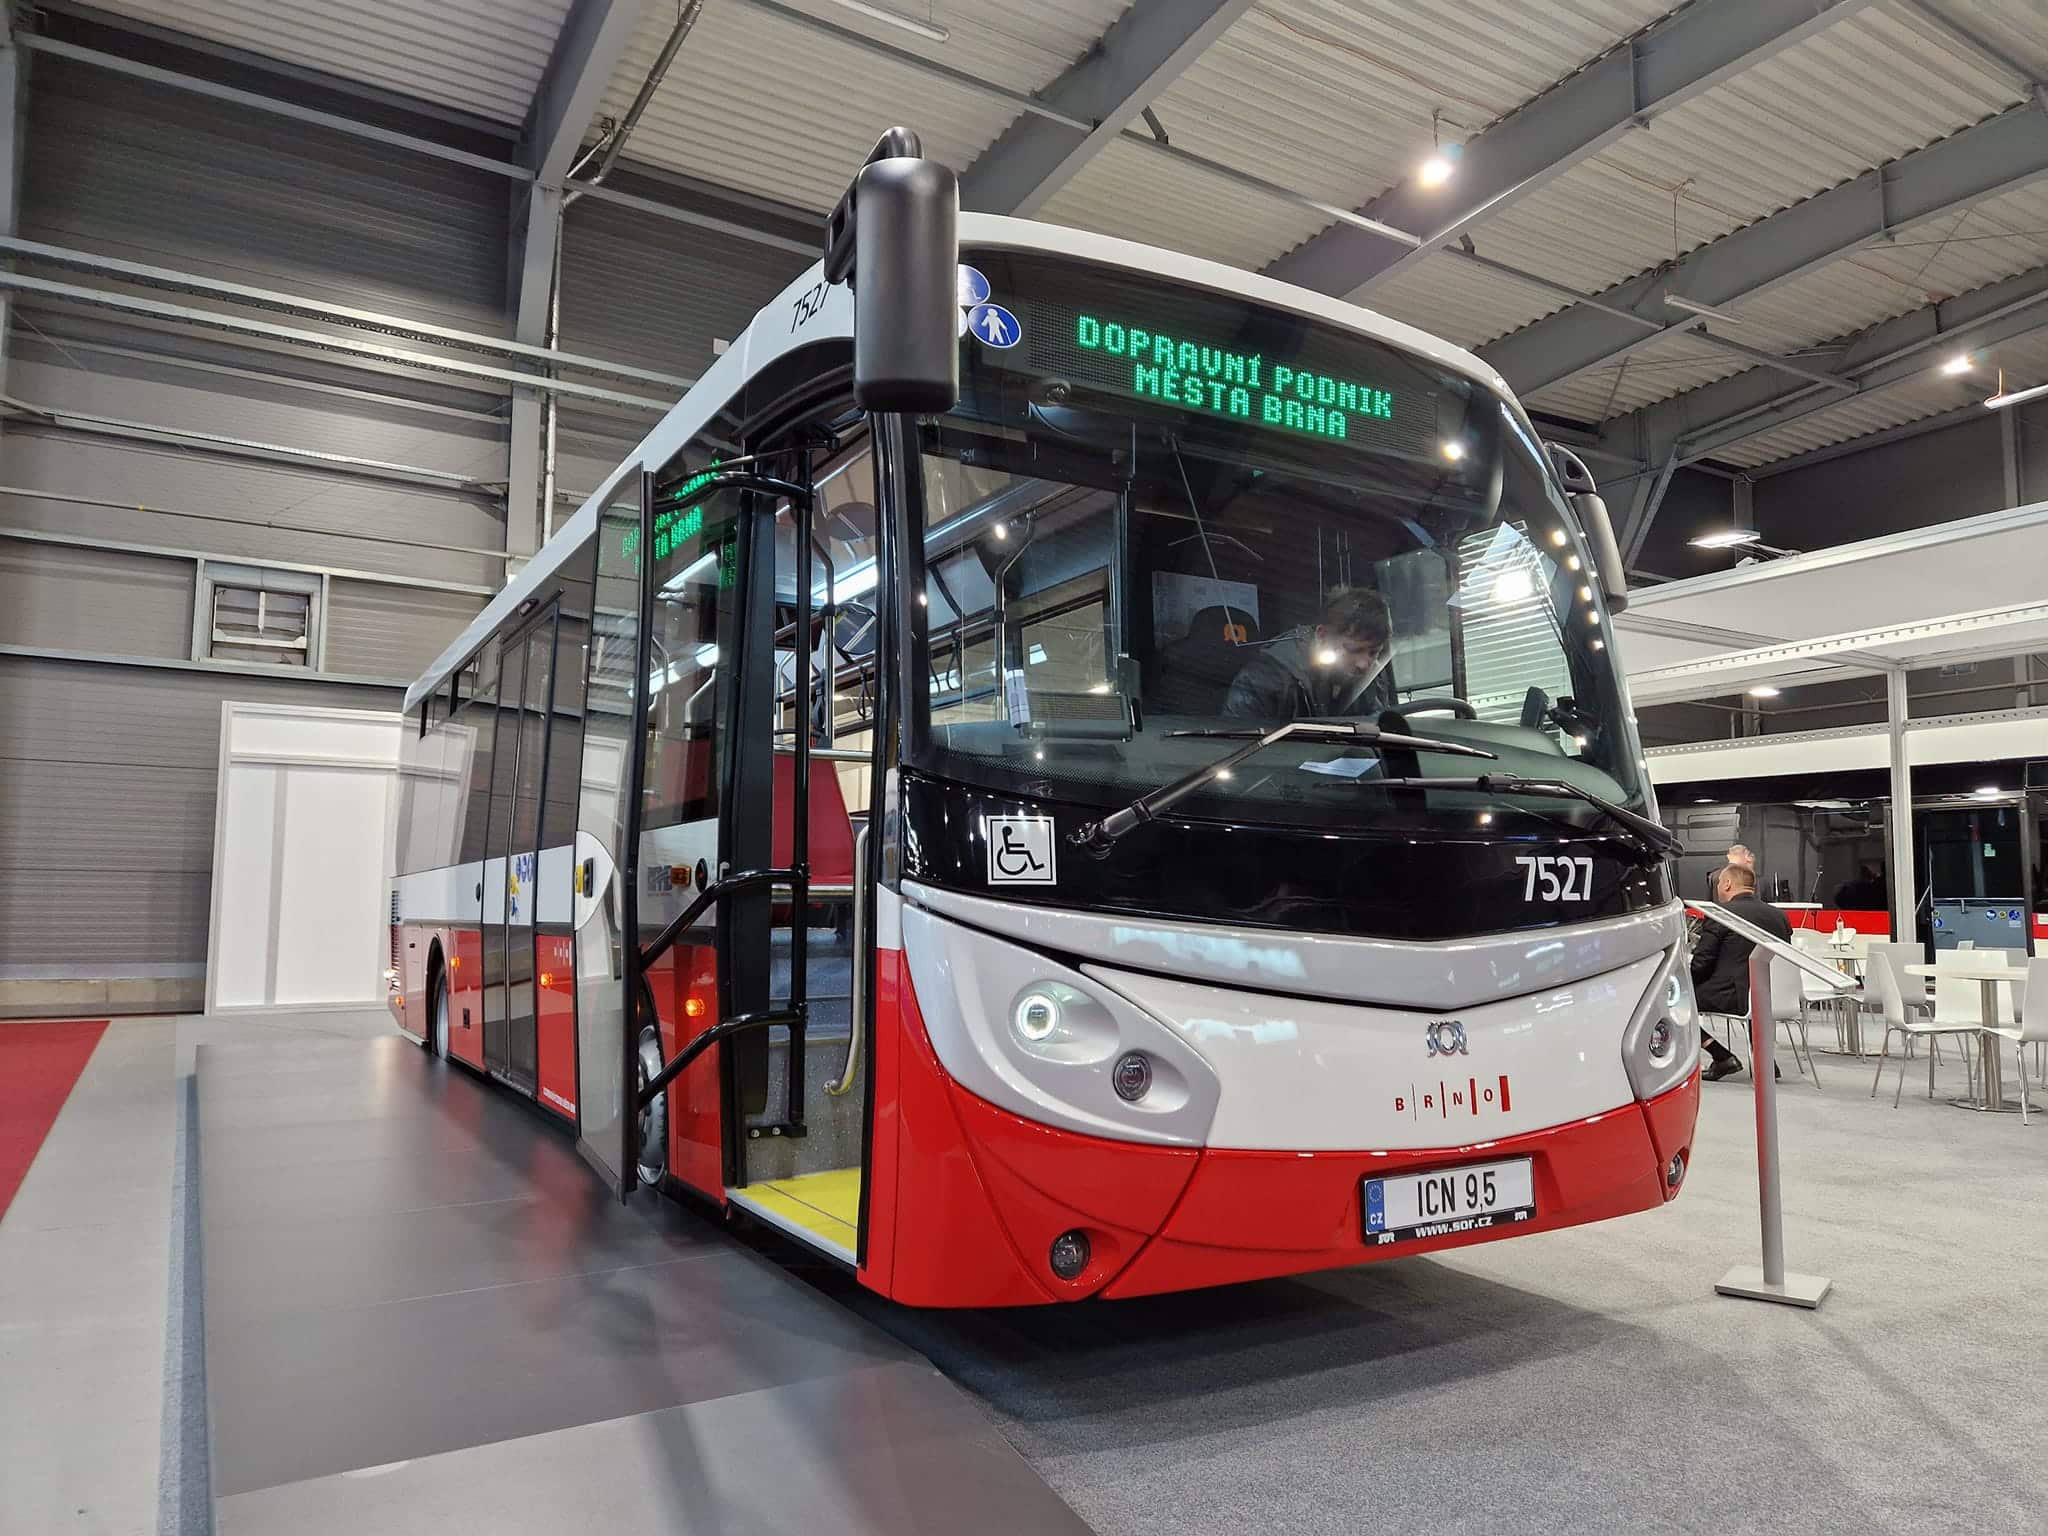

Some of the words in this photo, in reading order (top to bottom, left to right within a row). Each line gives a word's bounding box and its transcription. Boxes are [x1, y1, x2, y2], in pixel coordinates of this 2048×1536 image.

[790, 280, 831, 334] 7527
[1075, 313, 1262, 388] DOPRAVNÍ
[1273, 364, 1392, 420] PODNIK
[1134, 362, 1250, 418] MĚSTA
[1262, 394, 1347, 440] BRNA
[1515, 856, 1593, 902] 7527
[1370, 1212, 1384, 1226] CZ
[1417, 1176, 1456, 1217] ICN
[1415, 1216, 1493, 1239] www.sor.cz
